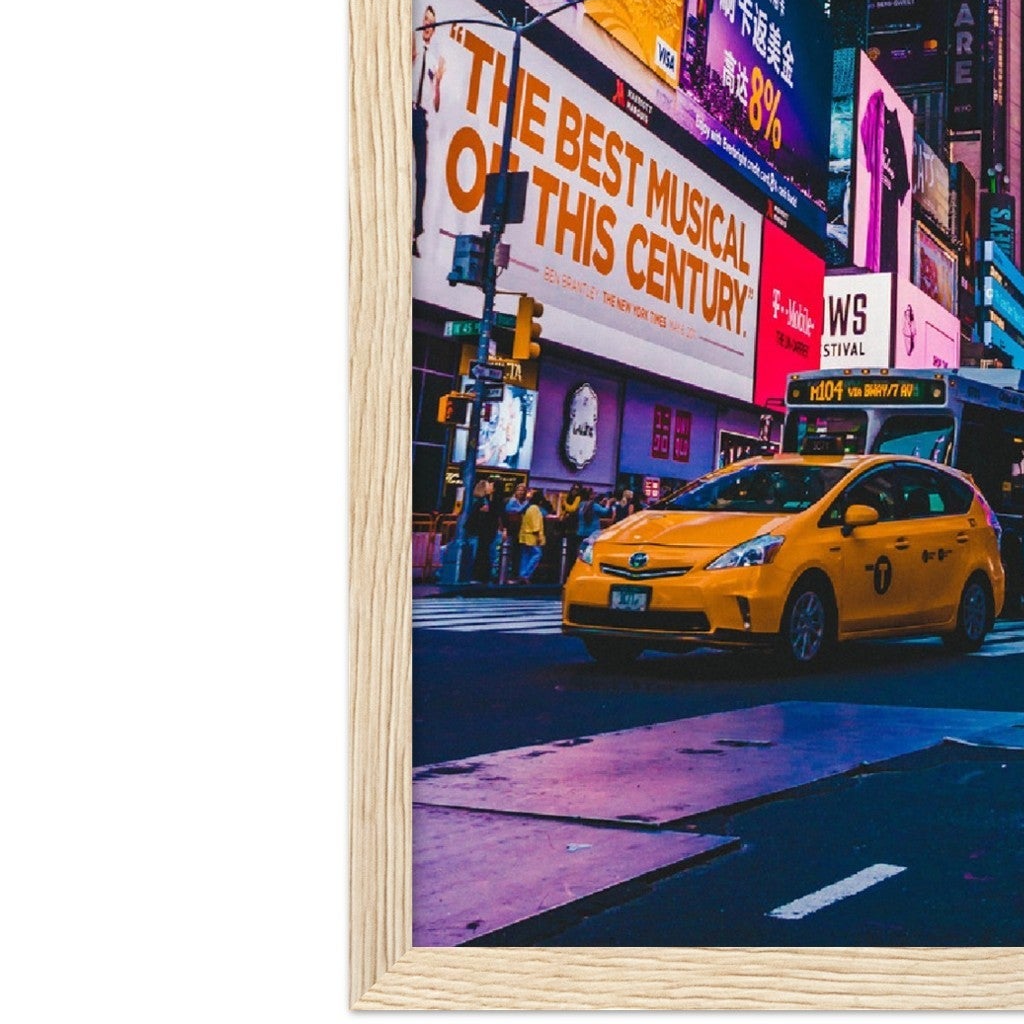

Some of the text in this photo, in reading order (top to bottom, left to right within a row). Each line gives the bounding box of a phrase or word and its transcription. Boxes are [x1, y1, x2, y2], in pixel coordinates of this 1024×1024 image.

[658, 43, 675, 72] VISA
[555, 96, 644, 207] BEST
[646, 158, 750, 276] MUSICAL
[532, 166, 617, 276] THIS
[823, 342, 866, 357] STIVAL
[810, 380, 844, 402] M104
[900, 383, 914, 397] AV
